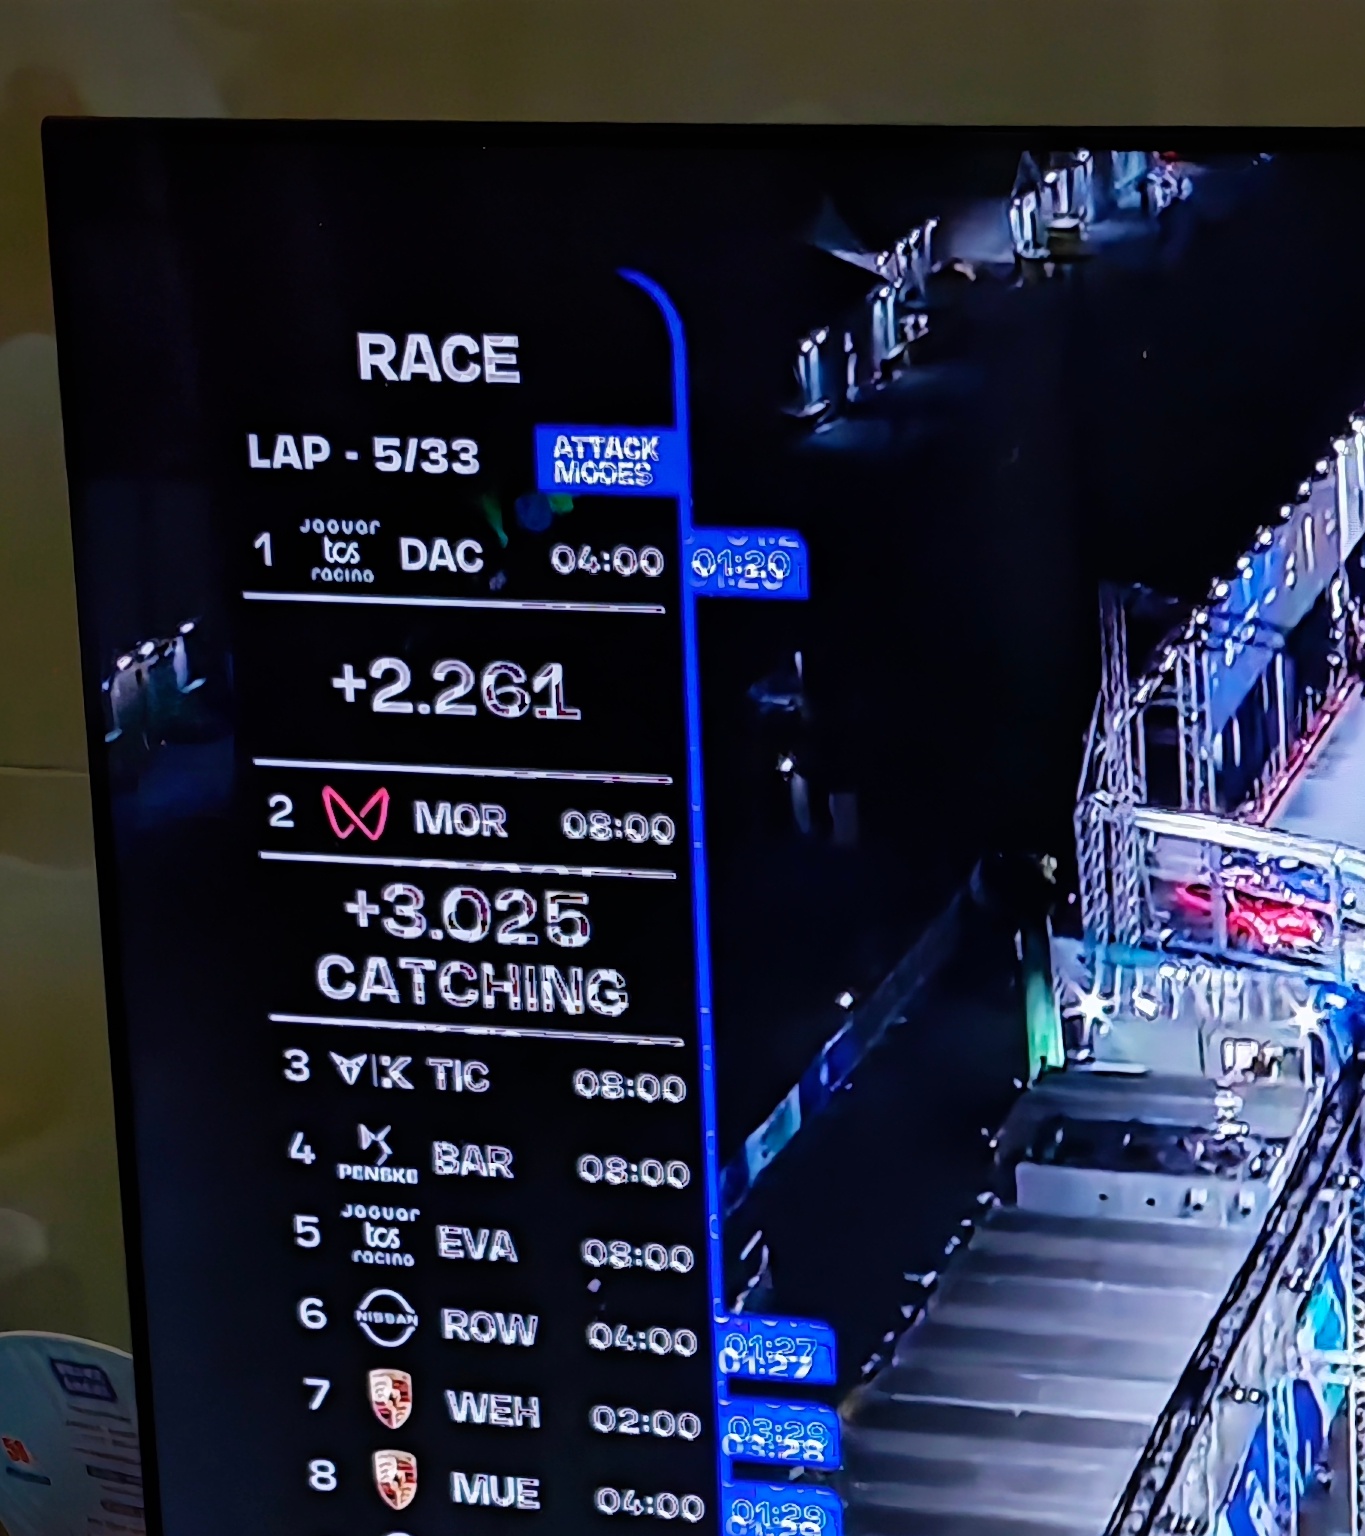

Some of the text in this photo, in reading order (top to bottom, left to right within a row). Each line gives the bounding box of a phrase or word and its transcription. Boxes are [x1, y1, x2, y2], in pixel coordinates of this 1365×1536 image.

[358, 333, 520, 383] RACE
[249, 434, 330, 469] LAP
[374, 437, 479, 474] 5/33
[554, 435, 660, 461] ATTACK
[255, 533, 272, 566] 1
[400, 537, 483, 573] DAC
[551, 545, 664, 577] 04:00
[333, 658, 581, 720] +2.261
[269, 795, 675, 845] 2 MOR 08:00
[346, 883, 590, 947] +3.025
[316, 954, 630, 1017] CATCHING
[285, 1049, 309, 1081] 3
[426, 1057, 489, 1092] TIC
[573, 1070, 686, 1103] 08:00
[289, 1132, 690, 1189] 4 BAR 08:00
[294, 1215, 320, 1247] 5
[437, 1225, 518, 1262] EVA
[582, 1239, 694, 1273] 08:00
[299, 1298, 327, 1329] 6
[442, 1309, 538, 1346] ROW
[588, 1323, 697, 1357] 04:00
[303, 1378, 330, 1410] 7
[446, 1390, 540, 1428] WEH
[592, 1406, 701, 1440] 02:00
[309, 1460, 336, 1491] 8
[452, 1472, 540, 1509] MUE
[597, 1488, 704, 1523] 04:00
